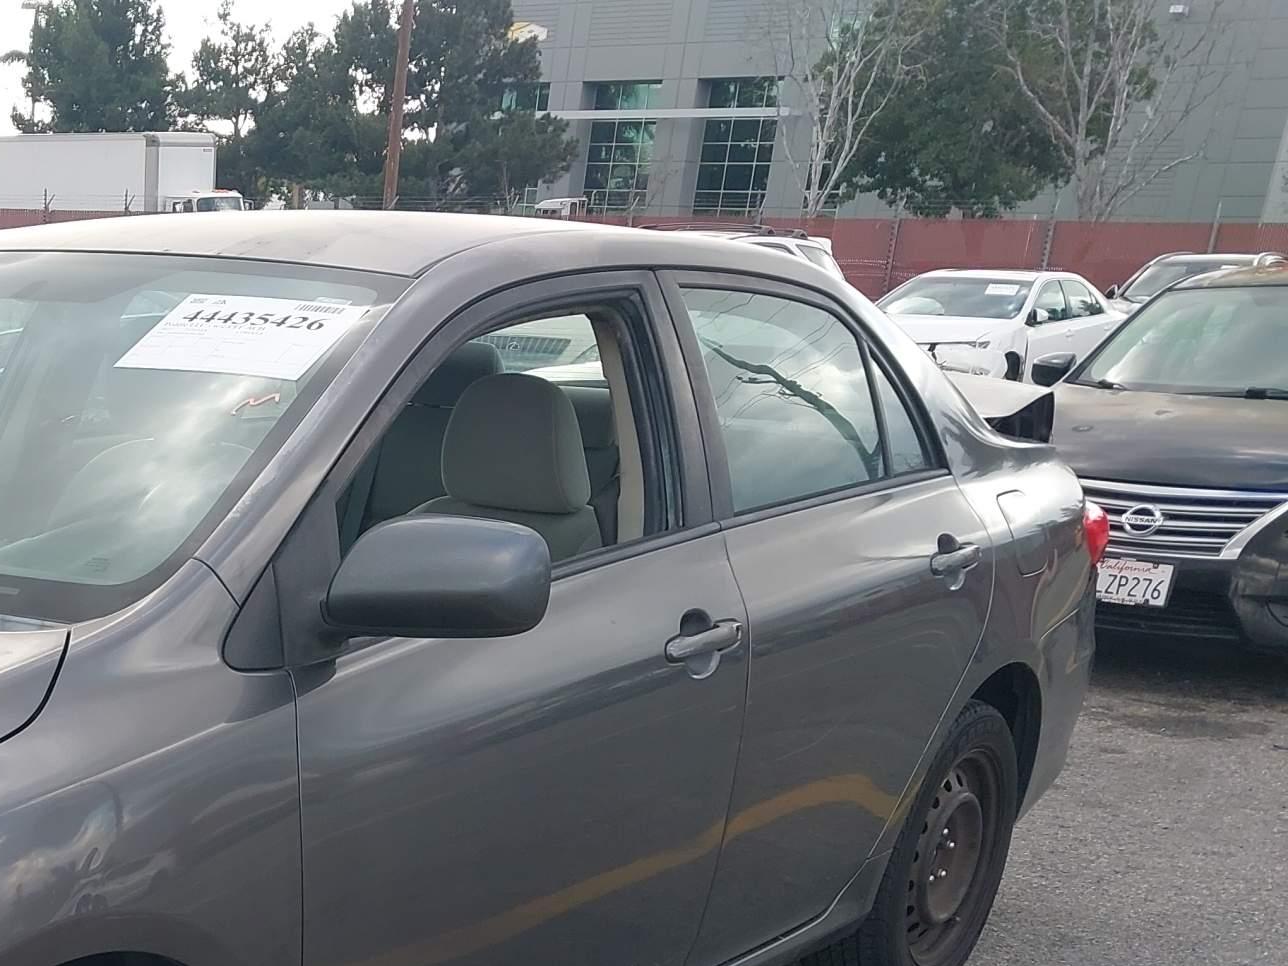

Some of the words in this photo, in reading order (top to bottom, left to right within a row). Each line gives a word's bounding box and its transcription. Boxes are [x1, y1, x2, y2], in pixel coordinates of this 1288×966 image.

[183, 309, 328, 331] 44435426
[1125, 516, 1158, 524] NISSAN
[1099, 559, 1158, 575] California
